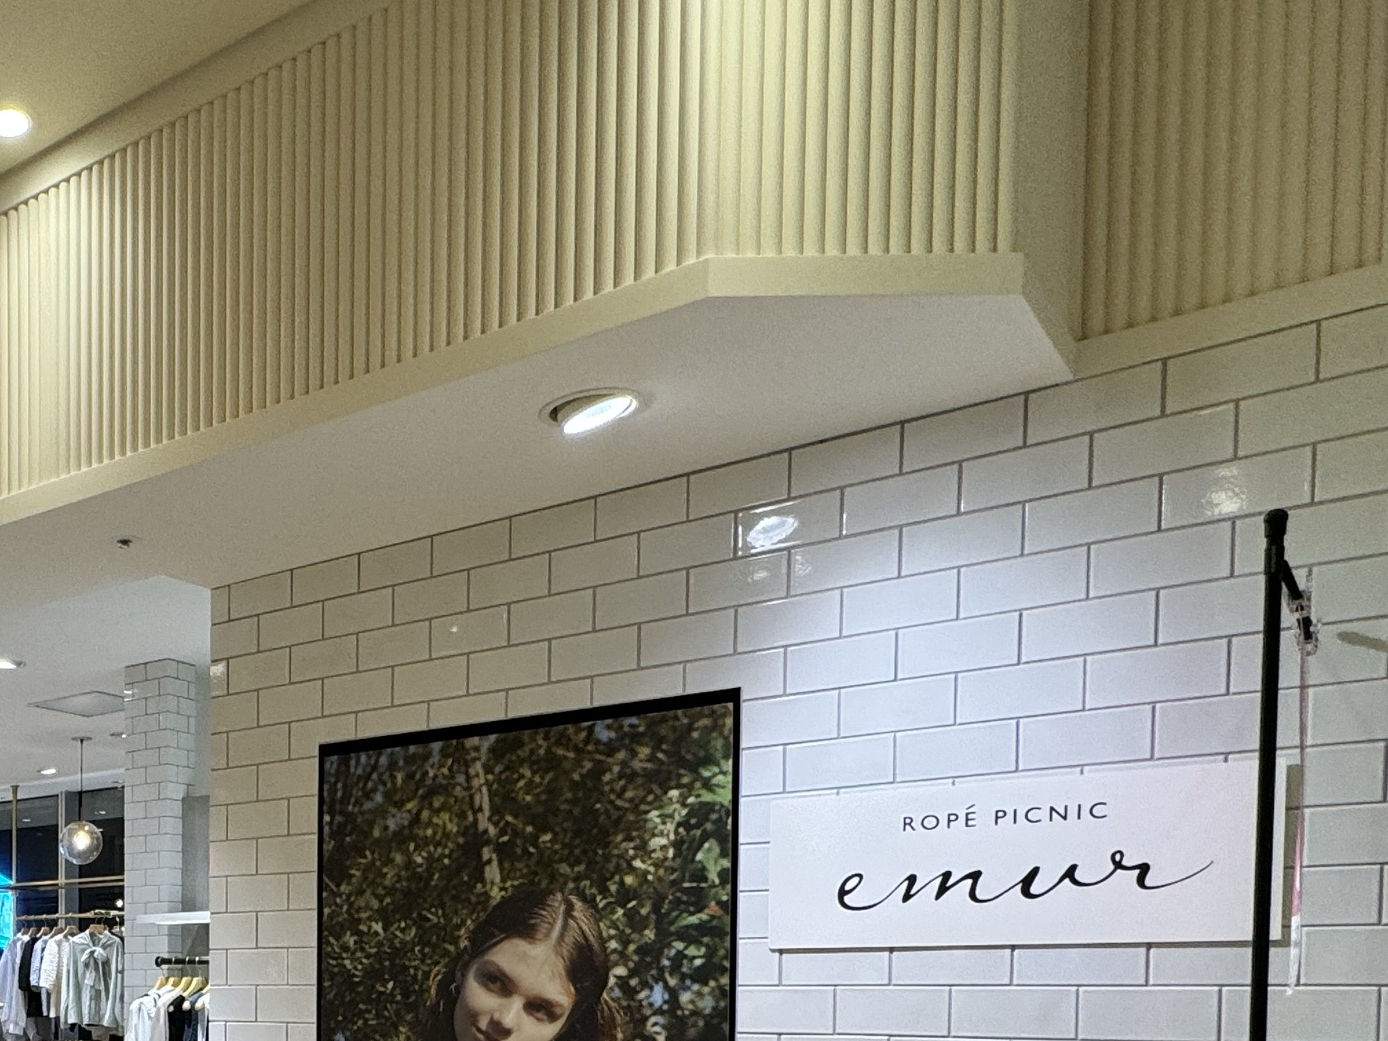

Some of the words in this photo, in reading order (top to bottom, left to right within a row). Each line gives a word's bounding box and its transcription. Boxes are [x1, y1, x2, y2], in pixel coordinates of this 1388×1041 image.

[902, 804, 977, 832] ROPÉ
[994, 801, 1109, 826] PICNIC
[837, 849, 1214, 911] emur
